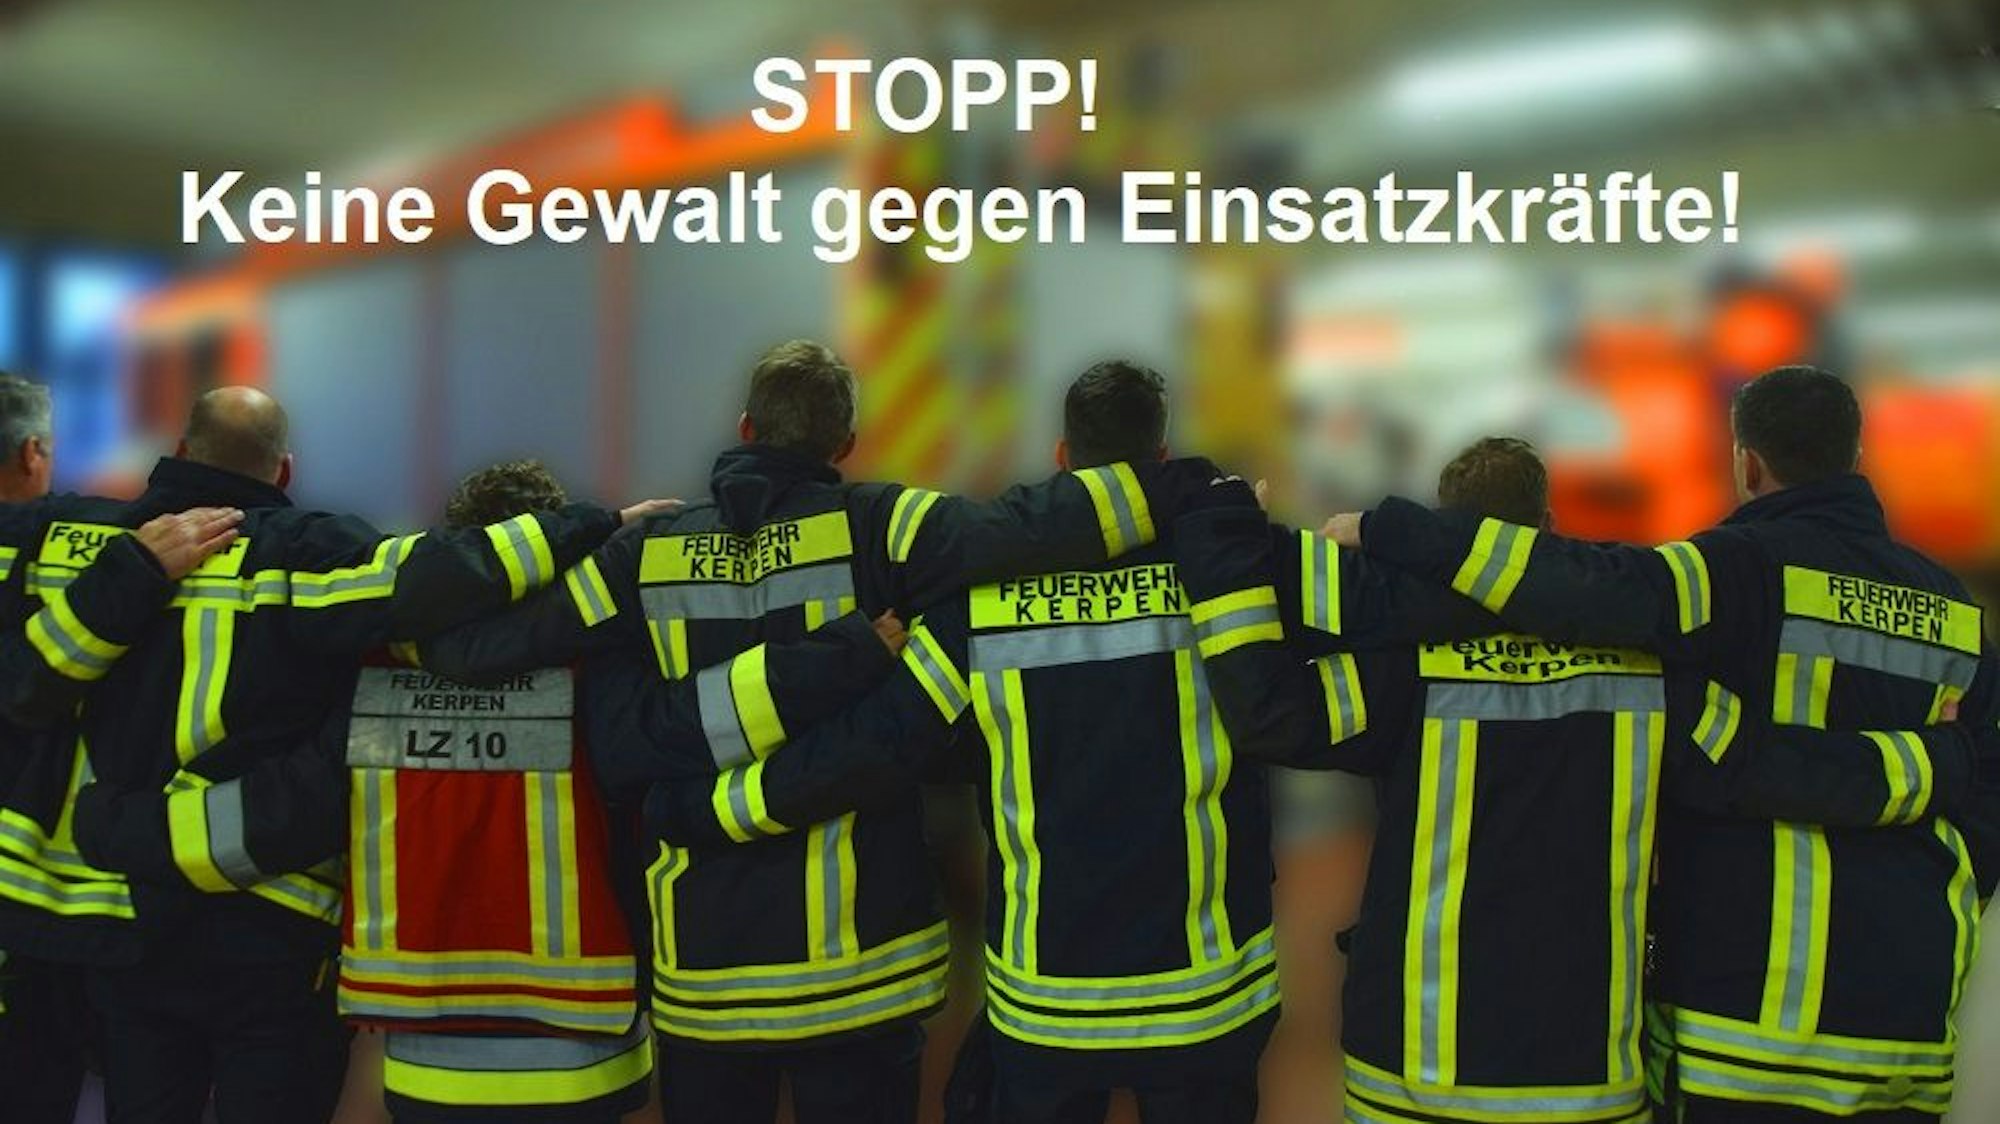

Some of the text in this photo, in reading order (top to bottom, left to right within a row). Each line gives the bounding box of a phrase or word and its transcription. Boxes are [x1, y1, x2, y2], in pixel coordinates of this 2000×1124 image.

[690, 546, 793, 580] KERPEN
[1016, 589, 1181, 623] KERPEN
[1828, 576, 1949, 621] FEUERWEHR
[1839, 600, 1943, 643] KERPEN
[1464, 653, 1621, 678] Kerpen
[412, 694, 505, 711] KERPEN
[406, 730, 507, 759] LZ 10
